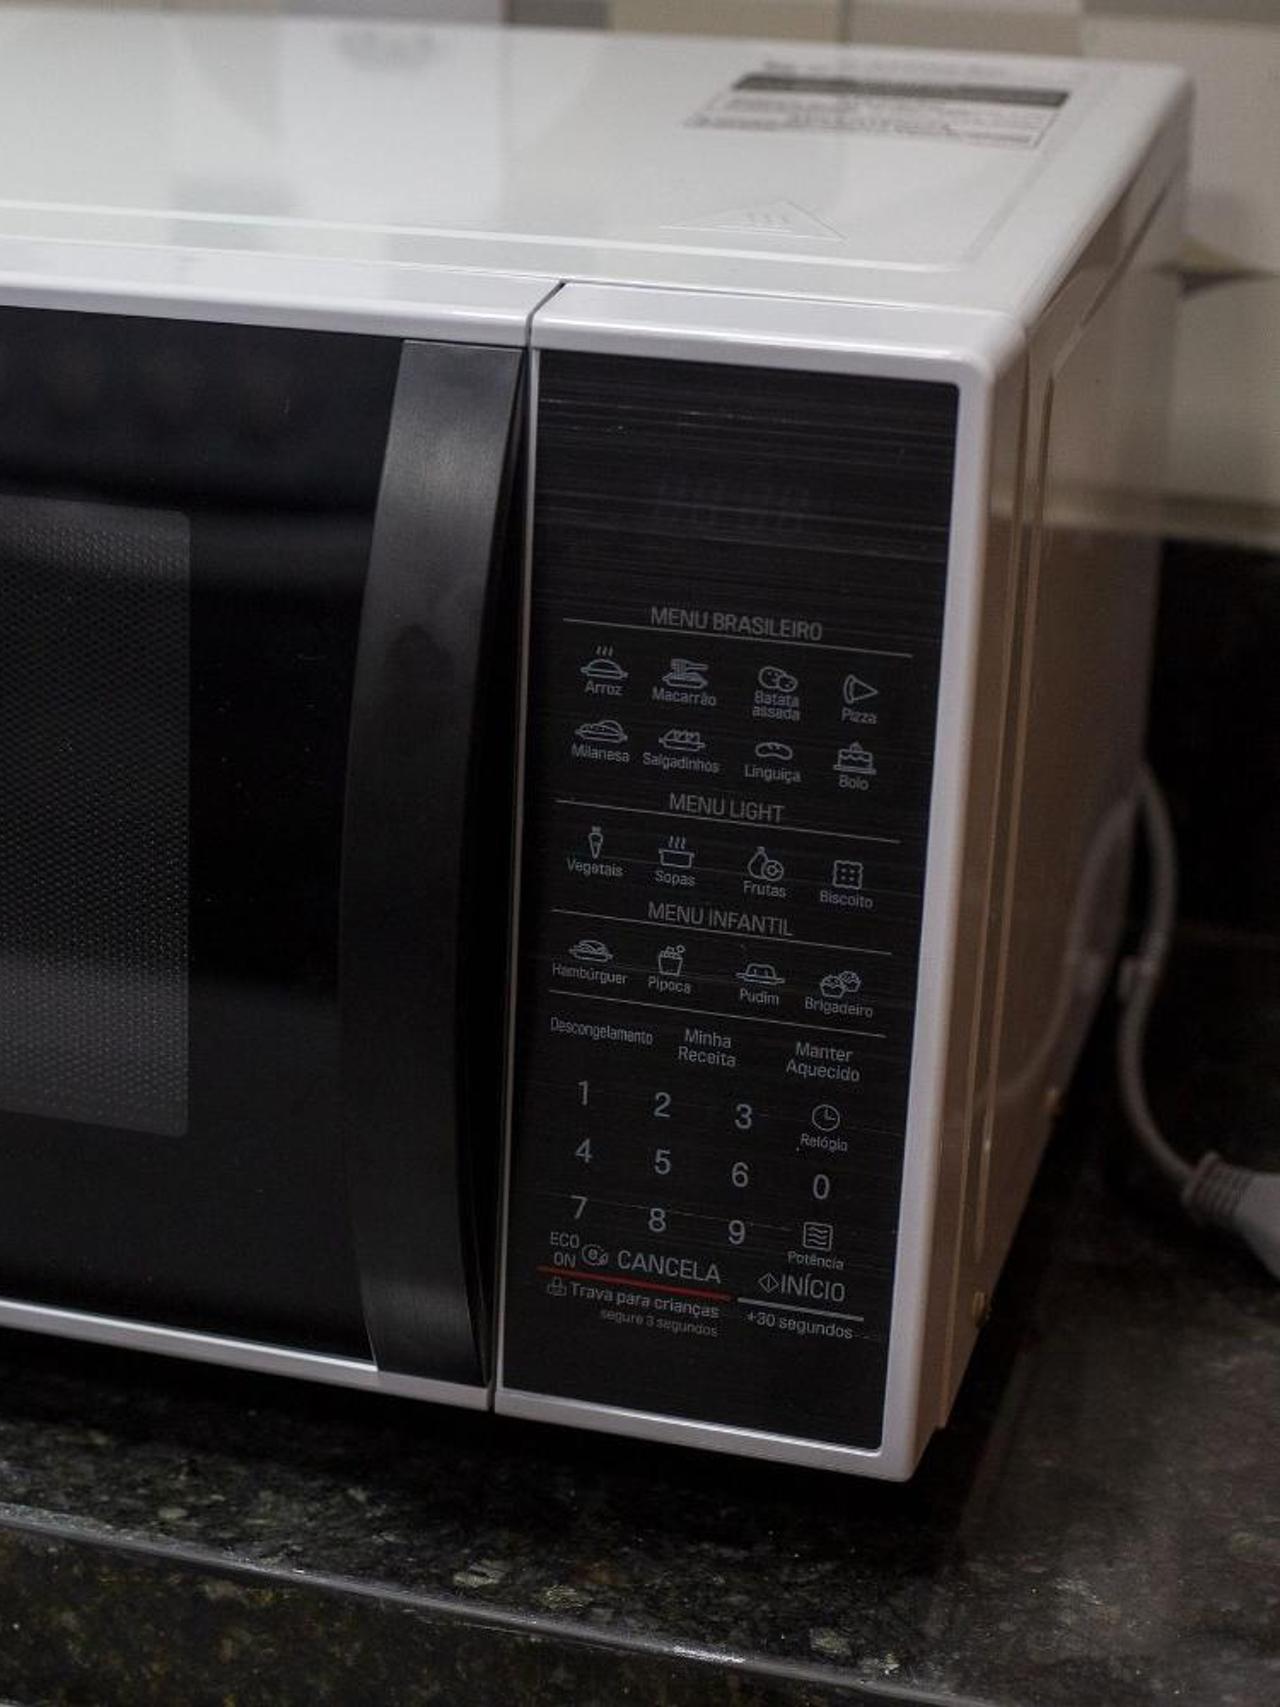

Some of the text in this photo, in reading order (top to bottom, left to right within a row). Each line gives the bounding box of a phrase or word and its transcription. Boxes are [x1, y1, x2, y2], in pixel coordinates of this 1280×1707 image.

[651, 606, 822, 641] MENU BRASILEIRO
[585, 679, 624, 696] Arroz
[652, 686, 717, 707] Macarrão
[754, 690, 800, 707] Batata
[841, 707, 877, 725] Pizza
[572, 743, 630, 763] Milanesa
[642, 751, 719, 774] Salgadinhos
[744, 763, 802, 784] Linguiça
[839, 774, 870, 791] Bolo
[670, 792, 784, 824] MENU LIGHT
[567, 857, 624, 878] Vegetais
[655, 869, 696, 888] Sopas
[744, 880, 786, 898] Frutas
[820, 890, 874, 910] Biscoito
[648, 902, 793, 936] MENU INFANTIL
[552, 962, 628, 985] Hambúrguer
[648, 976, 691, 994] Pipoca
[739, 988, 780, 1006] Pudim
[804, 996, 874, 1018] Brigadeiro
[550, 1017, 653, 1045] Descongelamento
[684, 1028, 732, 1049] Minha
[678, 1046, 736, 1068] Receita
[796, 1041, 854, 1063] Manter
[786, 1058, 860, 1083] Aquecido
[577, 1080, 590, 1106] 1
[654, 1092, 672, 1118] 2
[735, 1103, 753, 1130] 3
[575, 1137, 593, 1164] 4
[800, 1132, 848, 1152] Relógio
[654, 1149, 672, 1175] 5
[731, 1162, 749, 1188] 6
[813, 1174, 830, 1200] 0
[571, 1194, 588, 1221] 7
[648, 1206, 666, 1233] 8
[550, 1231, 580, 1249] ECO
[727, 1219, 746, 1246] 9
[553, 1249, 576, 1268] ON
[617, 1250, 720, 1284] CANCELA
[787, 1250, 844, 1270] Potência
[780, 1272, 846, 1302] INÍCIO
[570, 1280, 720, 1319] Trava para crianças
[600, 1308, 718, 1338] segure 3 segundos
[746, 1311, 854, 1340] +30 segundos
